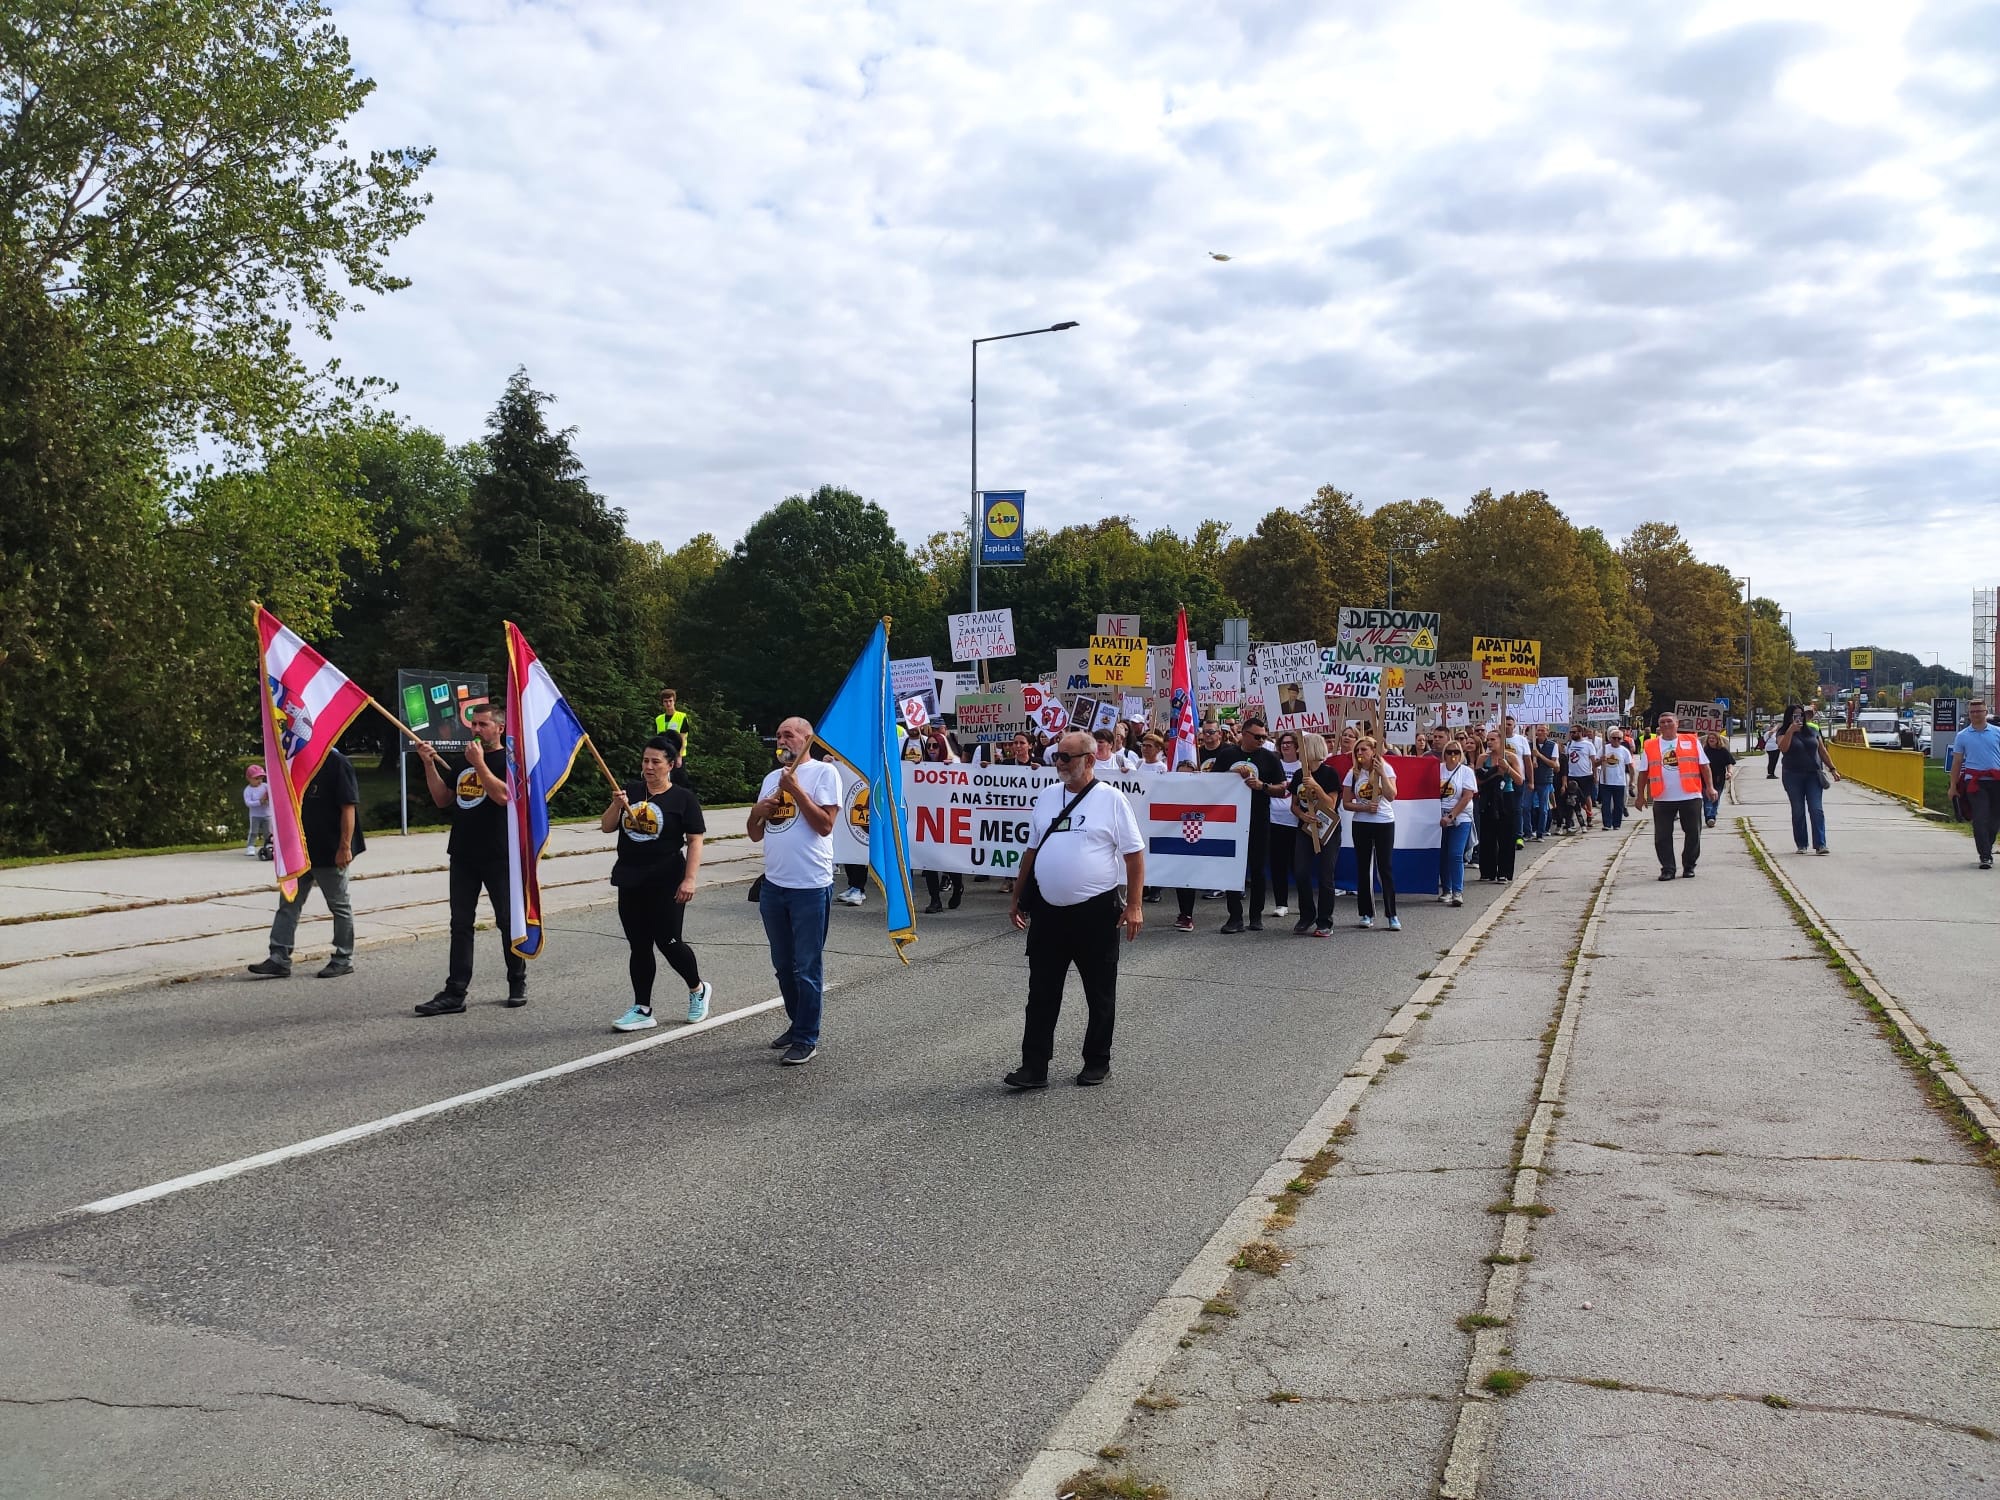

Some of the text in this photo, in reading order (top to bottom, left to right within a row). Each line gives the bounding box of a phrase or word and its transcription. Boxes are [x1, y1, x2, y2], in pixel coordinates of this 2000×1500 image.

[984, 544, 1010, 554] Isplati
[957, 612, 1006, 627] STRANAC
[1108, 618, 1130, 636] NE
[956, 632, 1007, 649] APATIJA
[1091, 636, 1144, 652] APATIJA
[1476, 639, 1533, 654] APATIJA
[954, 643, 1016, 660] GUTA SMRAD
[1282, 642, 1316, 657] NISMO
[1337, 640, 1365, 662] NA
[1094, 652, 1131, 667] KAŽE
[1509, 653, 1536, 666] DOM
[1105, 669, 1124, 681] NE
[1424, 670, 1469, 680] NE DAMO
[1325, 682, 1370, 697] PATIJU
[1415, 678, 1473, 693] APATIJU
[959, 703, 1003, 714] KUPUJETE
[1544, 708, 1564, 722] HR
[1677, 704, 1708, 718] FARME
[959, 714, 1000, 725] TRUJETE
[1301, 712, 1325, 728] NAJ
[1695, 717, 1722, 731] BOLE
[960, 722, 1025, 734] PRLJAVI PROFIT
[914, 769, 969, 785] DOSTA
[973, 774, 1027, 788] ODLUKA
[1031, 778, 1041, 789] U
[950, 791, 960, 804] A
[962, 792, 982, 805] NA
[985, 791, 1027, 807] ŠTETU
[915, 806, 973, 845] NE
[979, 819, 1030, 843] MEG
[971, 847, 985, 865] U
